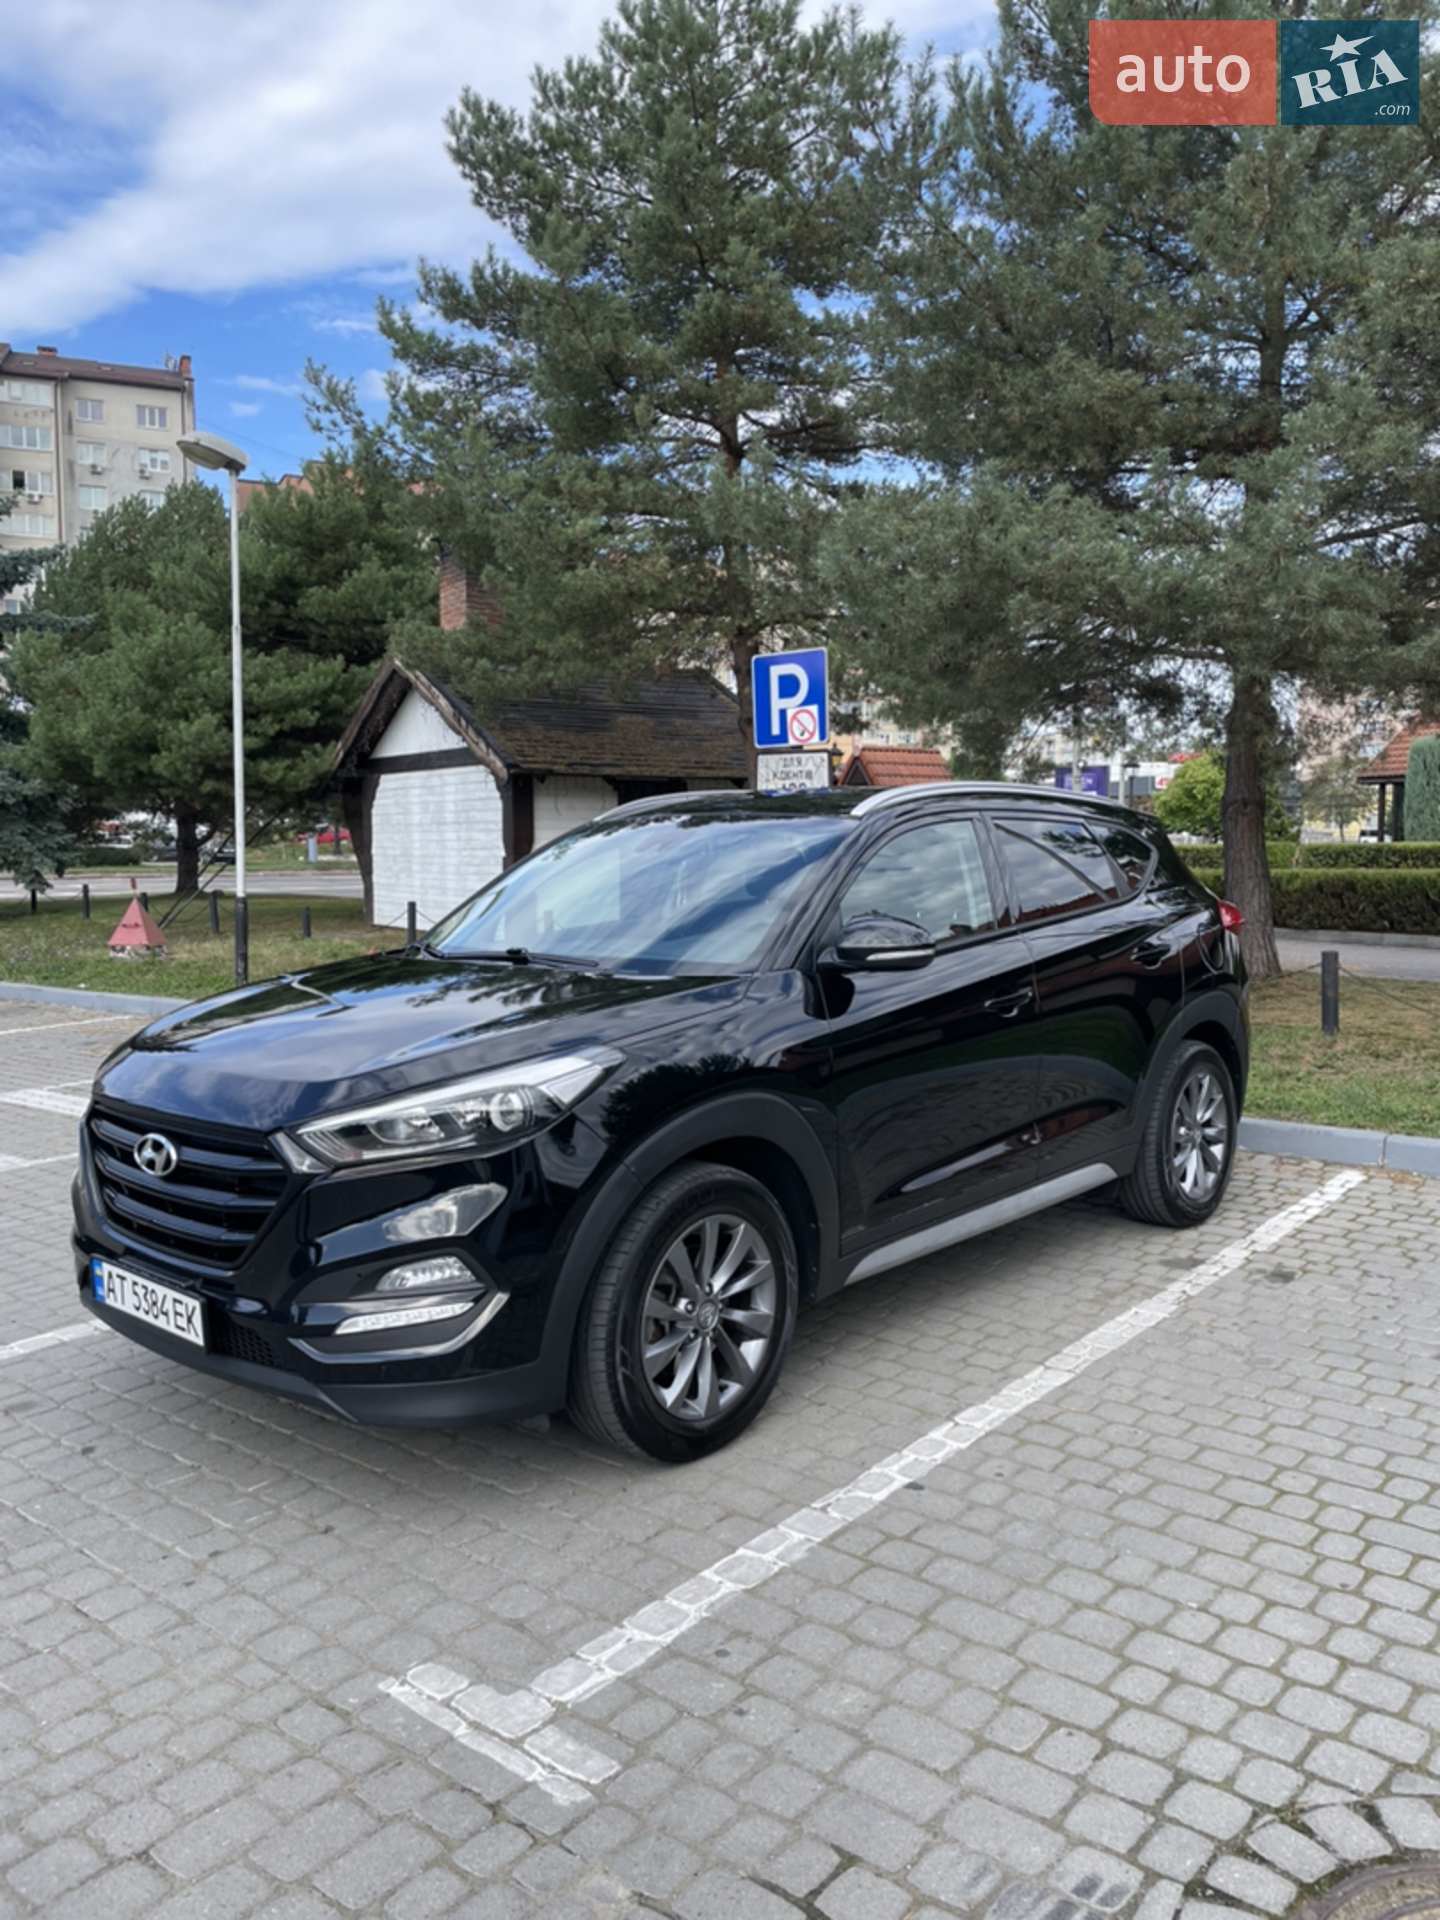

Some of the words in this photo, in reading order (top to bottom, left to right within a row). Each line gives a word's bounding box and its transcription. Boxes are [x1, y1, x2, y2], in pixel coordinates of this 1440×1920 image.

[769, 663, 810, 736] P
[106, 1270, 128, 1306] AT
[131, 1280, 171, 1326] 5384
[172, 1297, 201, 1339] EK
